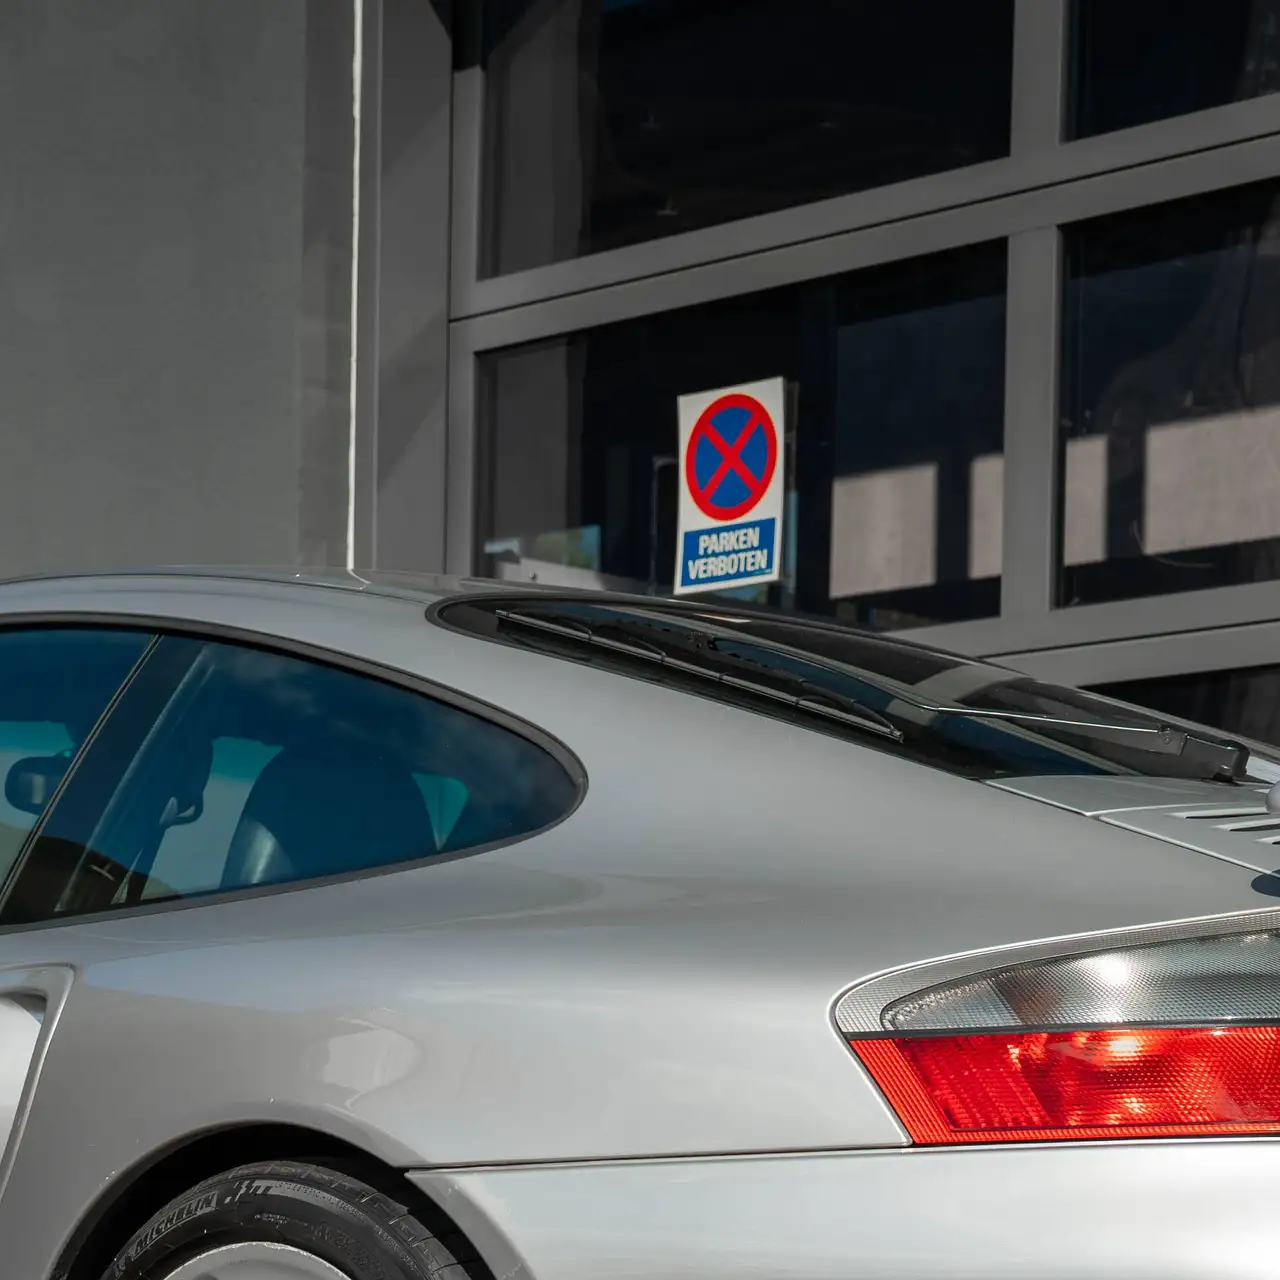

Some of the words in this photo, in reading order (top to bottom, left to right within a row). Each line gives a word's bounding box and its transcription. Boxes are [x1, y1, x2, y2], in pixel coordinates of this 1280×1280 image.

[698, 527, 760, 556] PARKEN
[688, 549, 767, 580] VERBOTEN
[134, 1190, 218, 1255] MICHELIN
